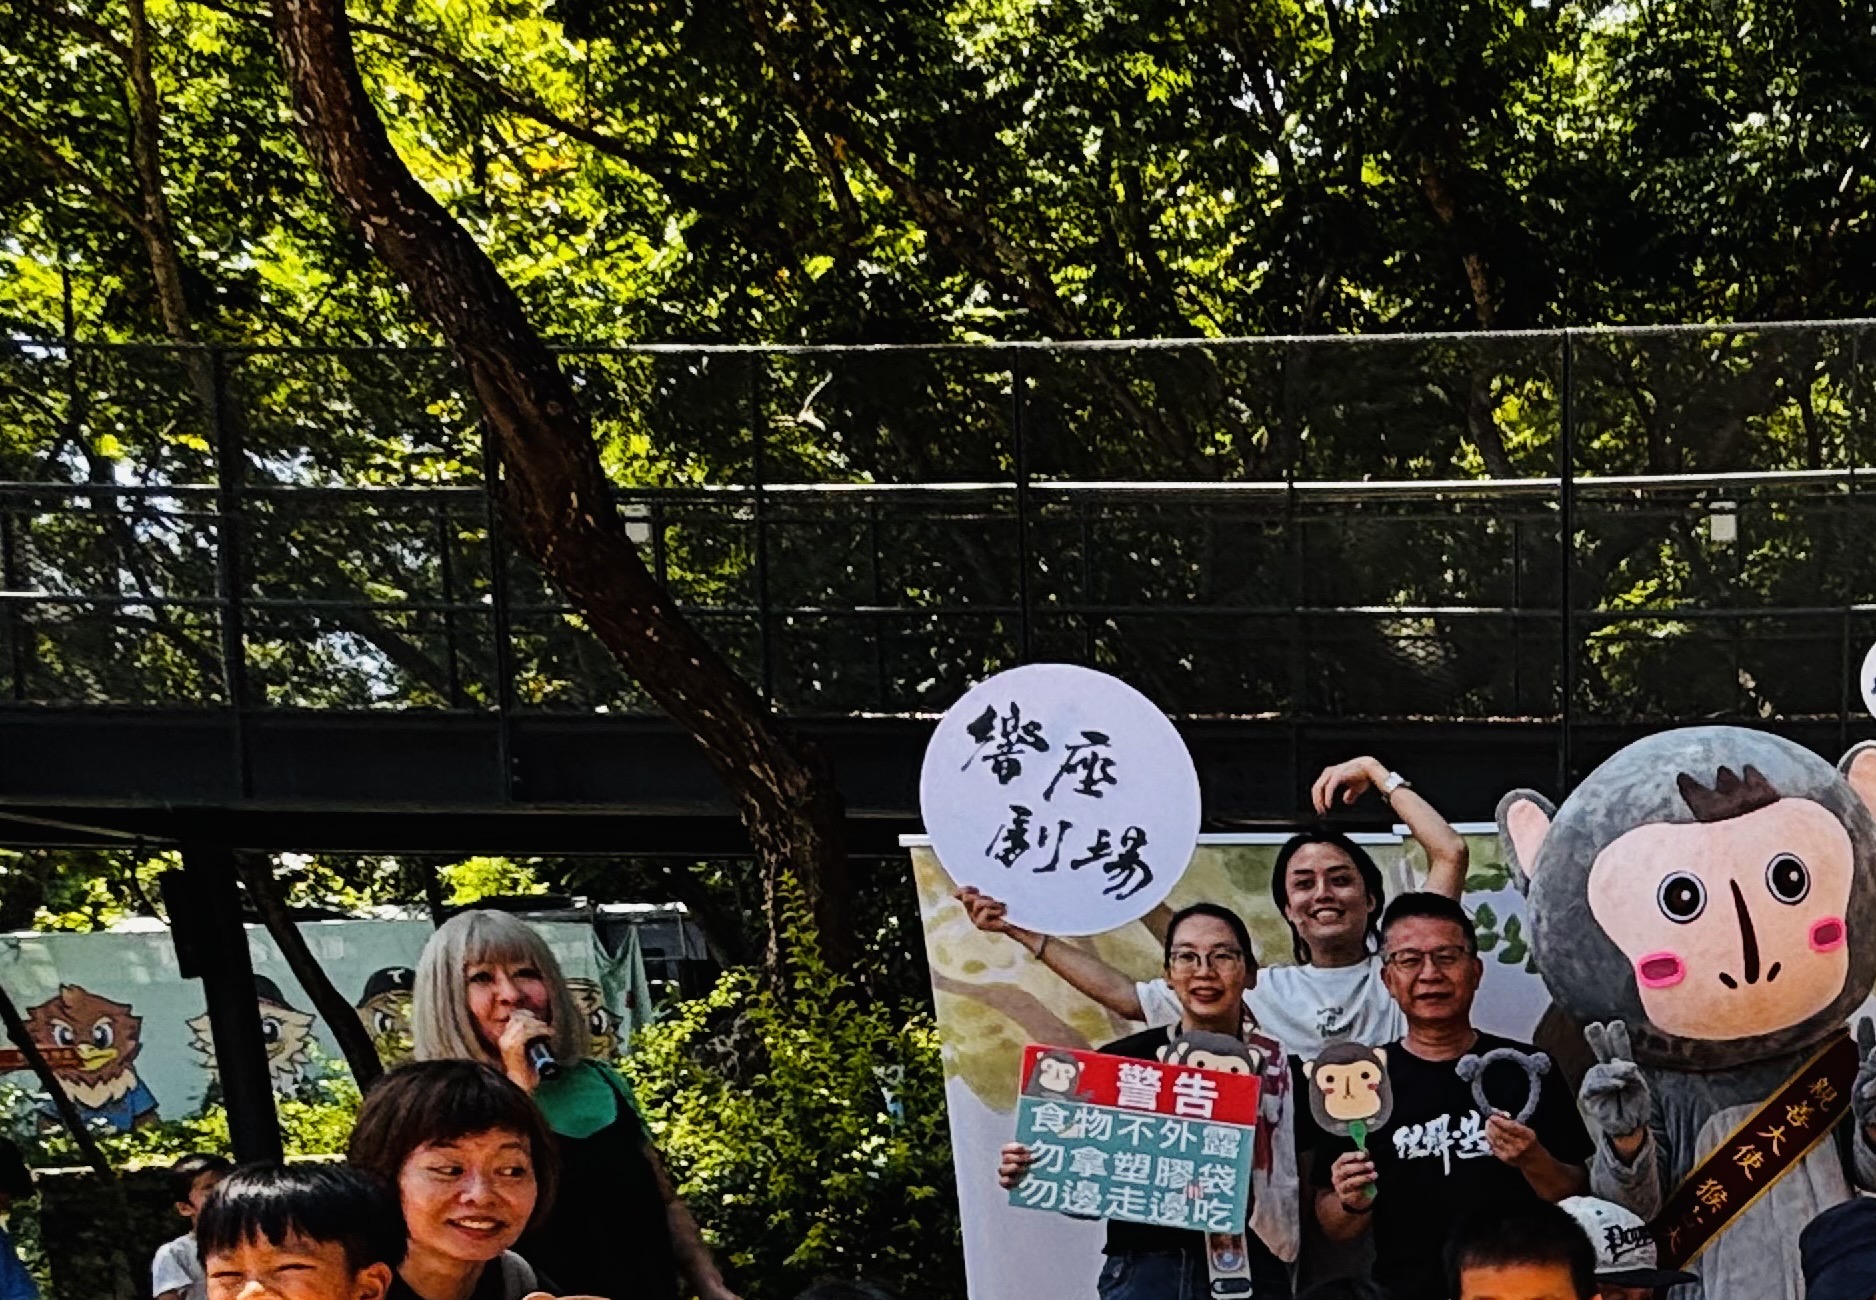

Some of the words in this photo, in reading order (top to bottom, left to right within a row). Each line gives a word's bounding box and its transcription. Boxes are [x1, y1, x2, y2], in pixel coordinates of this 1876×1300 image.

[1116, 1062, 1219, 1119] 警告
[1030, 1101, 1242, 1160] 食物不外露
[1028, 1139, 1237, 1198] 勿拿塑膠袋
[1018, 1173, 1234, 1232] 勿邊走邊吃
